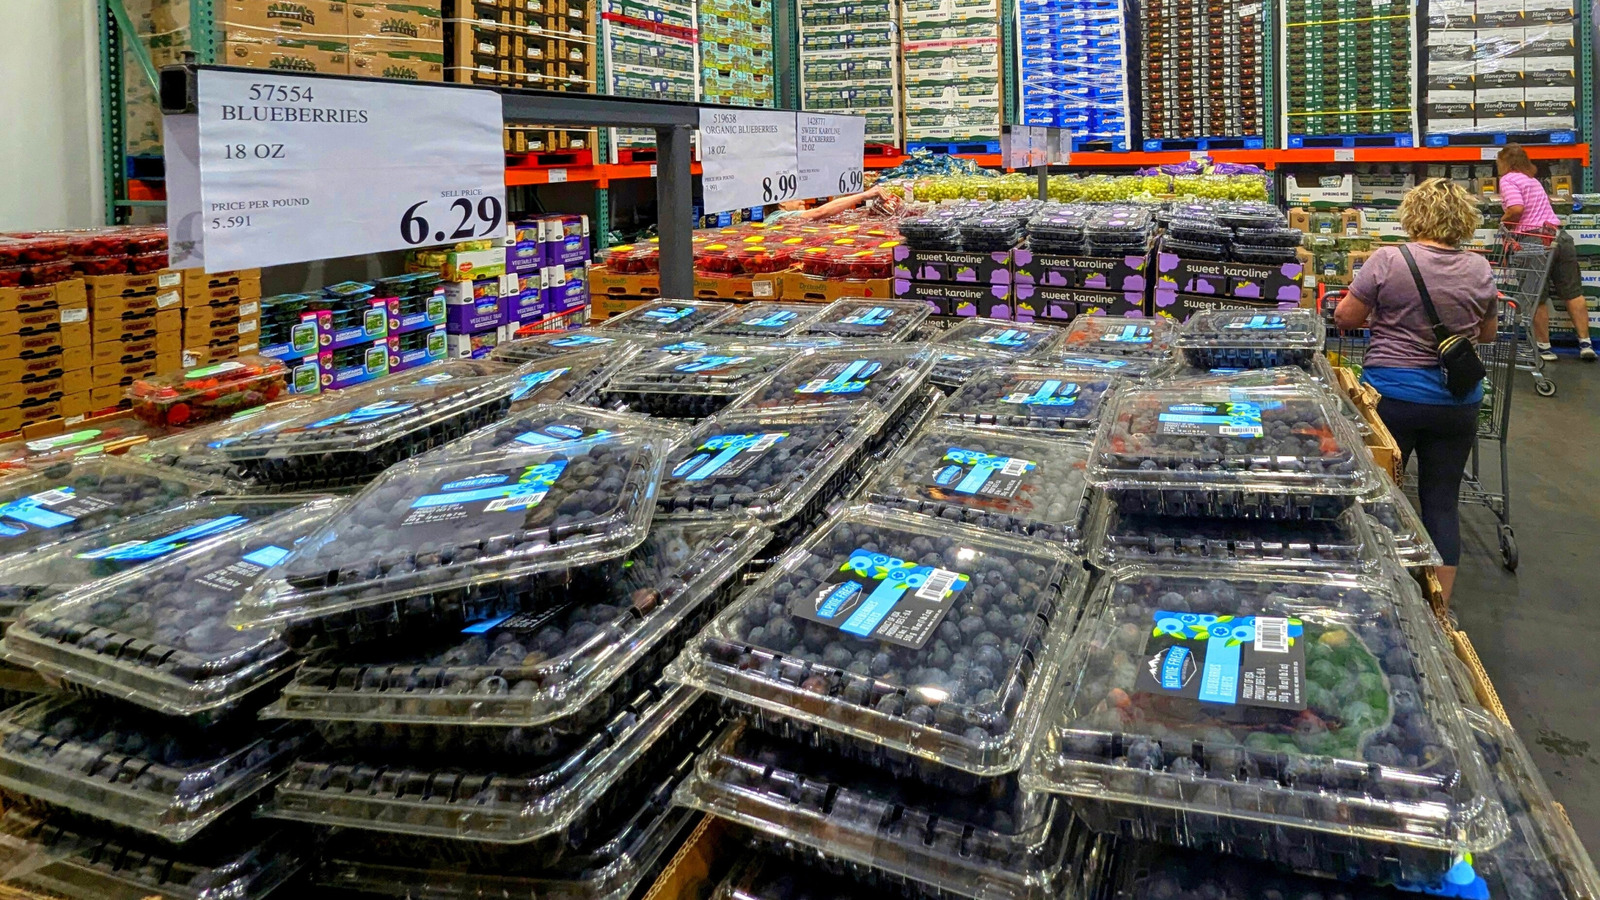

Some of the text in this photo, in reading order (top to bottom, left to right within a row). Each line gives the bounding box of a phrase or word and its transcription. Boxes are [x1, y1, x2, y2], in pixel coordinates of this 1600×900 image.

[1484, 13, 1517, 21] Honeycrisp
[1532, 41, 1567, 49] Honeycrisp
[249, 83, 314, 102] 57554
[1533, 101, 1568, 109] Honeycrisp
[222, 105, 368, 124] BLUEBERRIES
[713, 113, 737, 124] 519638
[705, 125, 778, 134] ORGANIC BLUEBERRIES
[801, 127, 841, 135] SWEET KAROLINE
[801, 135, 836, 143] BLACKBERRIES
[224, 143, 285, 159] 18 OZ
[708, 146, 727, 155] 18 OZ
[808, 144, 816, 152] OZ
[762, 174, 797, 203] 8.99
[838, 171, 863, 194] 6.99
[441, 188, 483, 198] SELL PRICE
[212, 197, 310, 212] PRICE PER POUND
[212, 216, 252, 230] 5.591
[401, 196, 502, 245] 6.29
[916, 253, 982, 264] sweet karoline
[1040, 258, 1114, 270] sweet karoline
[1186, 264, 1268, 279] sweet karoline
[916, 287, 982, 299] sweet karoline
[1041, 291, 1114, 304] sweet karoline
[1183, 299, 1217, 310] sweet
[444, 477, 505, 489] ALPINE FRESH
[821, 581, 860, 616] ALPINE FRESH
[876, 620, 892, 634] PRODUCT
[1162, 646, 1186, 687] ALPINE FRESH
[1242, 683, 1253, 698] PRODUCT
